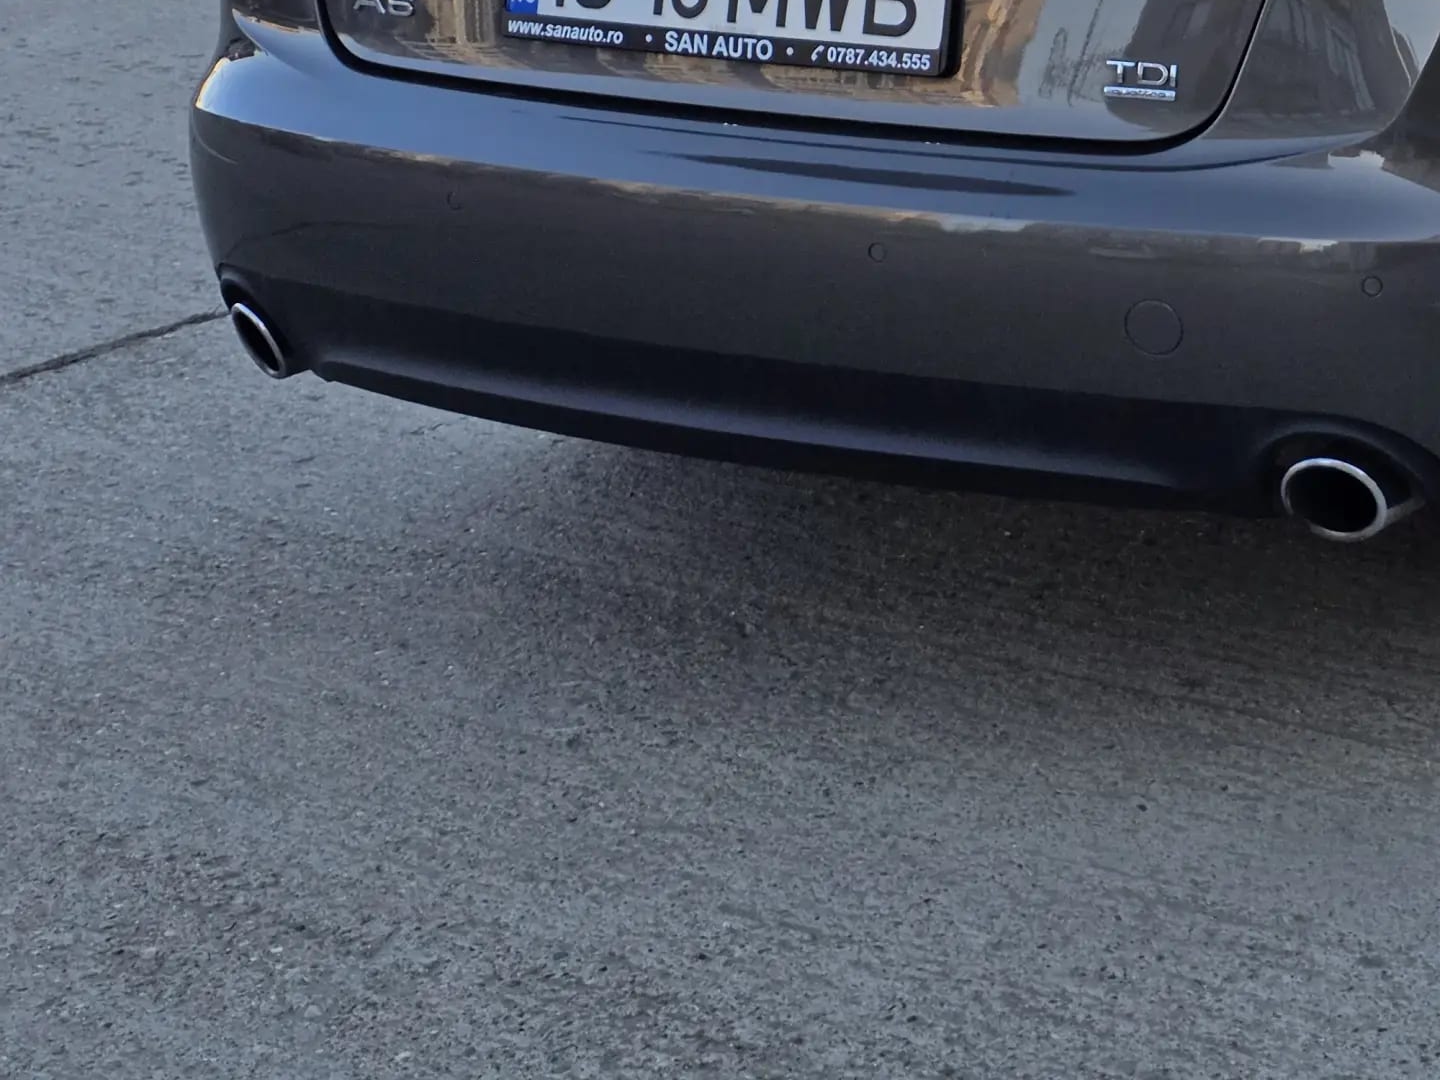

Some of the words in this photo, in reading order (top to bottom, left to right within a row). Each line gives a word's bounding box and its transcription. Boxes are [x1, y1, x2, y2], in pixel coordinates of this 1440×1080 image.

[508, 20, 623, 45] www.sanauto.ro
[665, 30, 708, 55] SAN
[712, 36, 773, 60] AUTO
[827, 46, 930, 70] 0787.434.555
[1106, 60, 1177, 87] TDI
